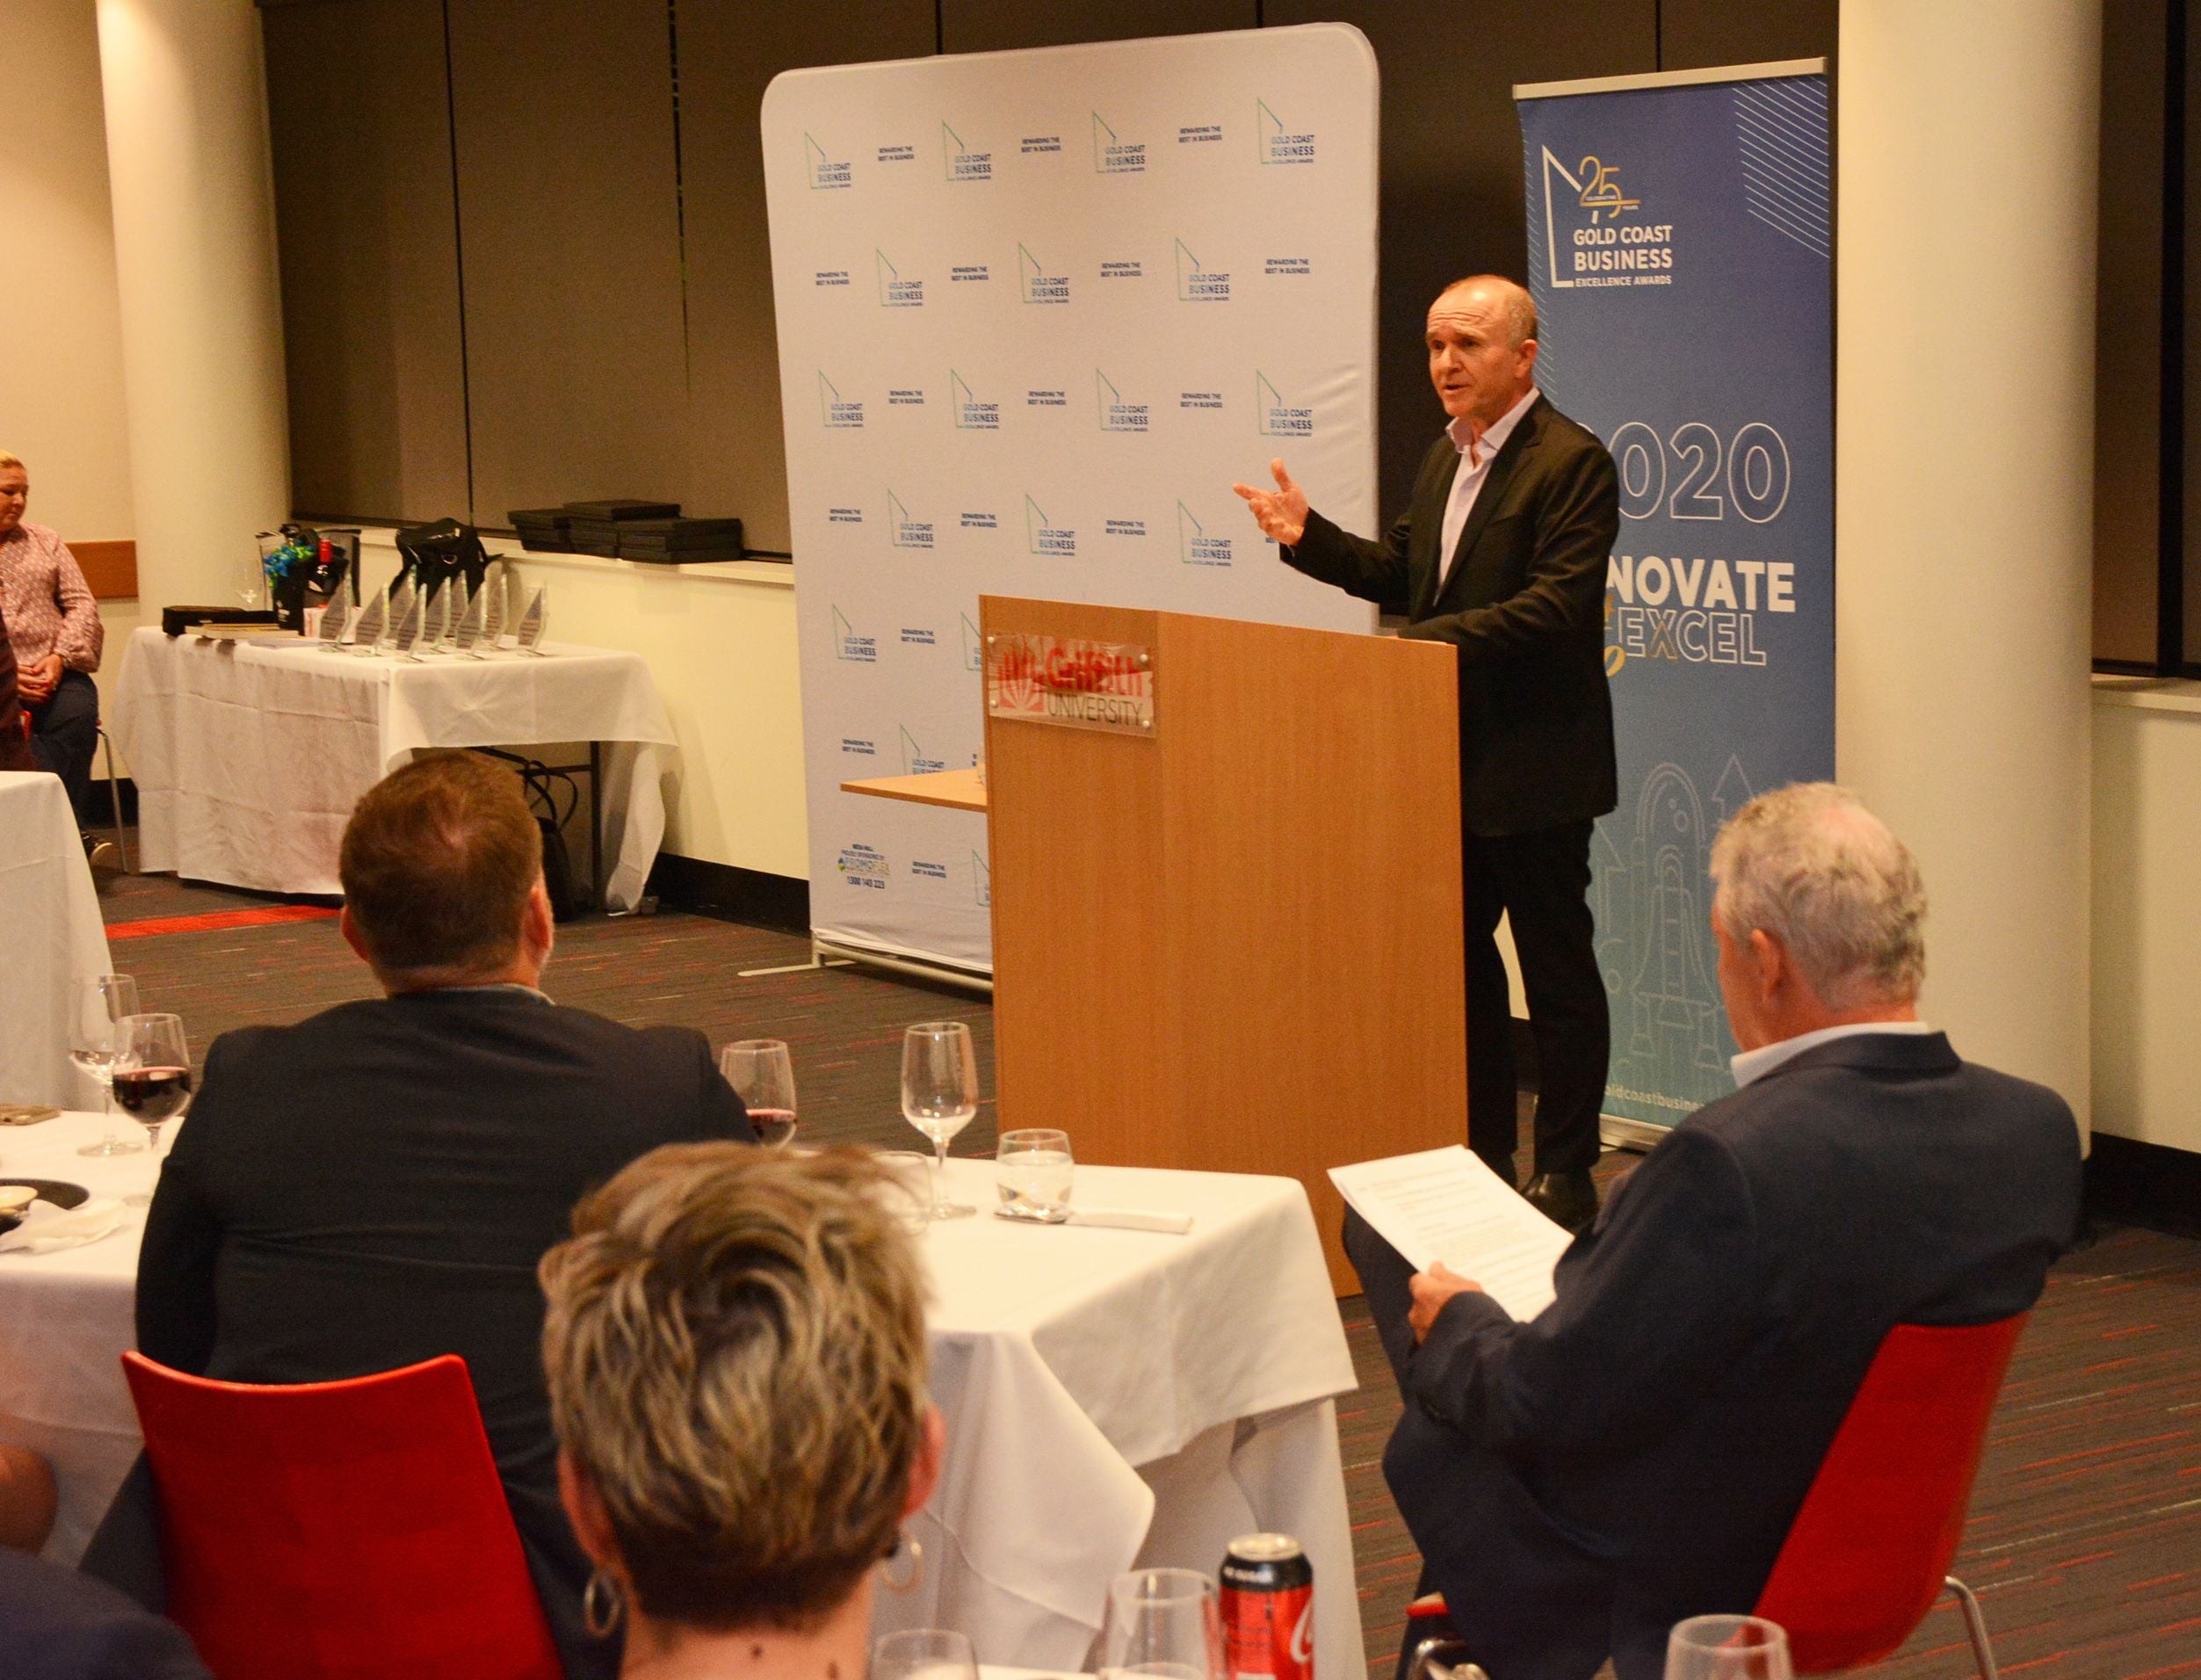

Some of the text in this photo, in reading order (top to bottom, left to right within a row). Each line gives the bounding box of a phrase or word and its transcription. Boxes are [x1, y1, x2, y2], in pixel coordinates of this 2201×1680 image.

[1272, 135, 1315, 145] GOLD COAST
[1106, 145, 1147, 156] GOLD COAST
[1272, 146, 1315, 157] BUSINESS
[973, 154, 992, 163] COAST
[1106, 155, 1147, 167] BUSINESS
[956, 163, 993, 175] BUSINESS
[819, 172, 852, 184] BUSINESS
[1580, 156, 1640, 218] 25
[1574, 225, 1673, 246] GOLD COAST
[1574, 249, 1673, 272] BUSINESS
[1032, 278, 1048, 286] GOLD
[1190, 274, 1206, 283] GOLD
[1575, 274, 1671, 288] EXCELLENCE AWARDS
[1032, 287, 1070, 298] BUSINESS
[1190, 285, 1230, 294] BUSINESS
[889, 292, 924, 301] BUSINESS
[832, 413, 865, 422] BUSINESS
[965, 414, 1000, 423] BUSINESS
[1271, 409, 1288, 417] GOLD
[1111, 416, 1149, 425] BUSINESS
[1271, 420, 1314, 430] BUSINESS
[1577, 422, 1791, 524] 020
[901, 532, 935, 542] BUSINESS
[1039, 539, 1076, 550] BUSINESS
[1192, 538, 1232, 548] GOLD COAST
[1192, 548, 1233, 561] BUSINESS
[1618, 606, 1767, 666] EXCEL
[845, 647, 877, 656] BUSINESS
[1046, 692, 1143, 726] UNIVERSITY
